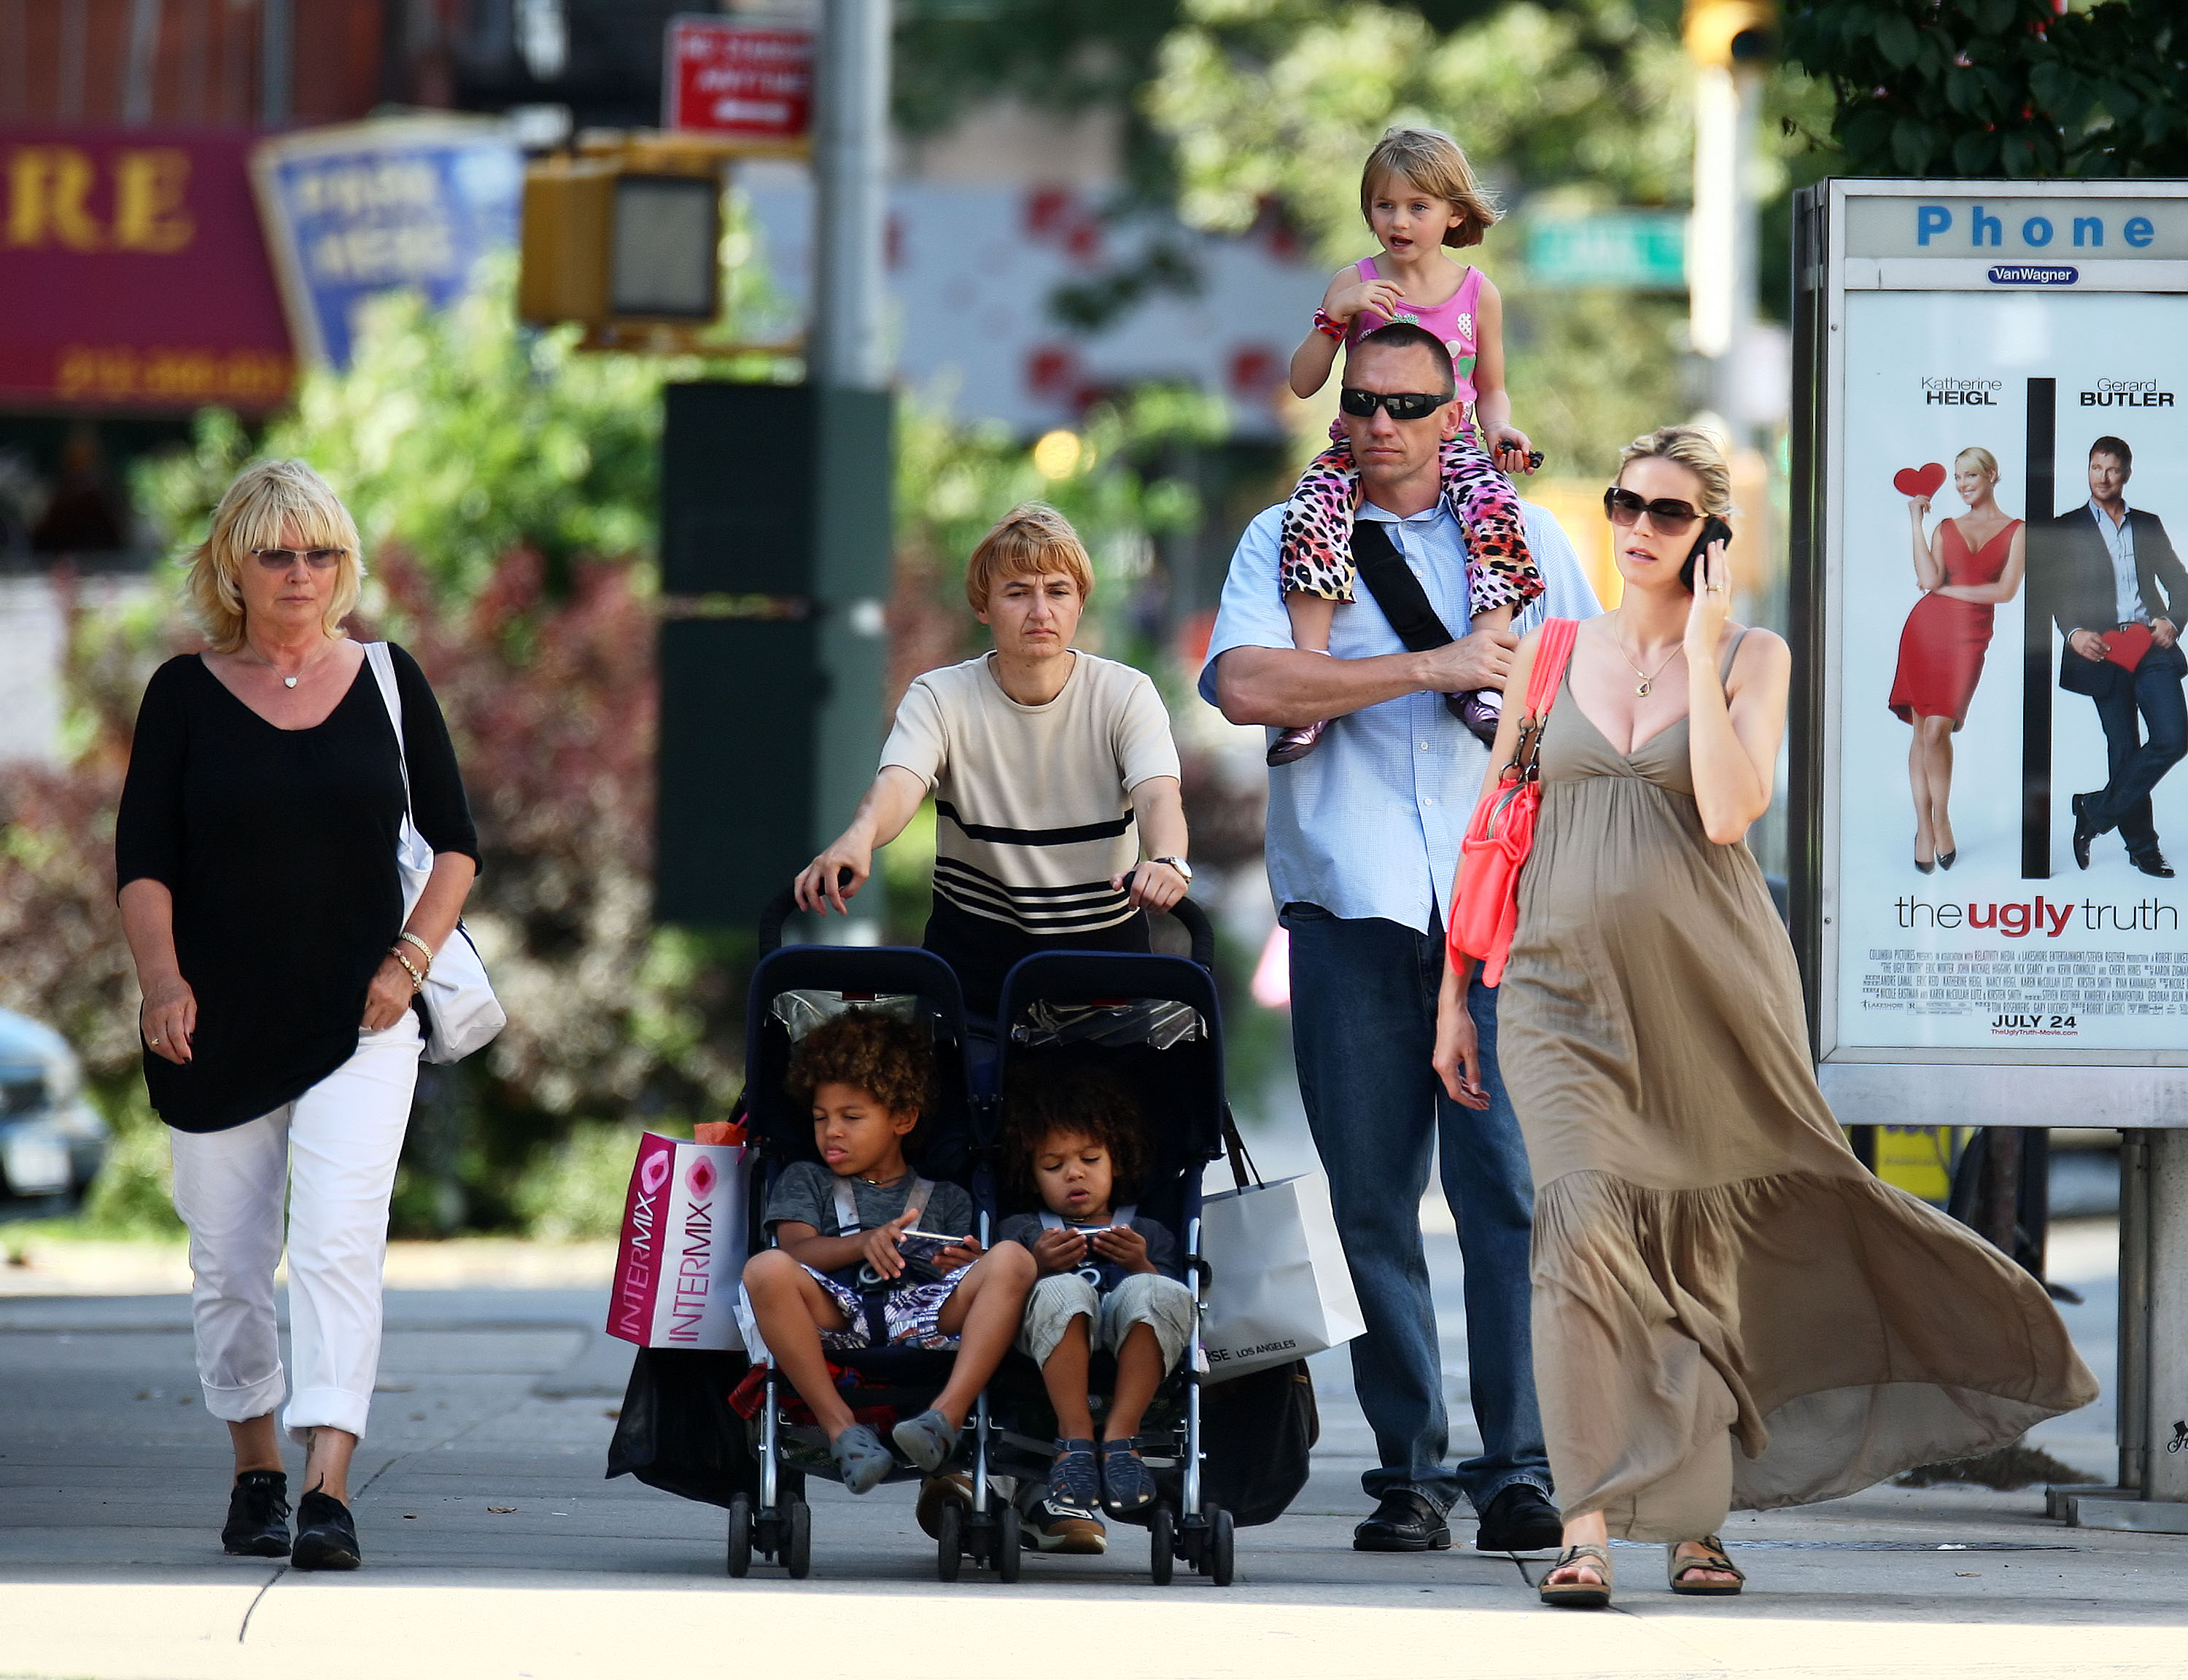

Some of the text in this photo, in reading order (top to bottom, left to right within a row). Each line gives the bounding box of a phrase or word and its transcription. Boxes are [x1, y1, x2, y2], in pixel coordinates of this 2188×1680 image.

[6, 148, 195, 253] RE
[1917, 205, 2156, 248] Phone
[1993, 267, 2072, 284] VanWagner
[1921, 376, 2003, 391] Katherine
[2096, 377, 2157, 392] Gerard
[1926, 391, 1998, 406] HEIGL
[2079, 392, 2176, 408] BUTLER
[1895, 895, 2179, 938] the ugly truth
[1992, 1015, 2076, 1029] JULY 24
[1991, 1029, 2079, 1037] TheUglyTruth-Movie.com
[619, 1191, 657, 1336] INTERMIX
[668, 1202, 713, 1342] INTERMIX
[1236, 1348, 1255, 1358] LOS
[1256, 1339, 1296, 1354] ANGELES
